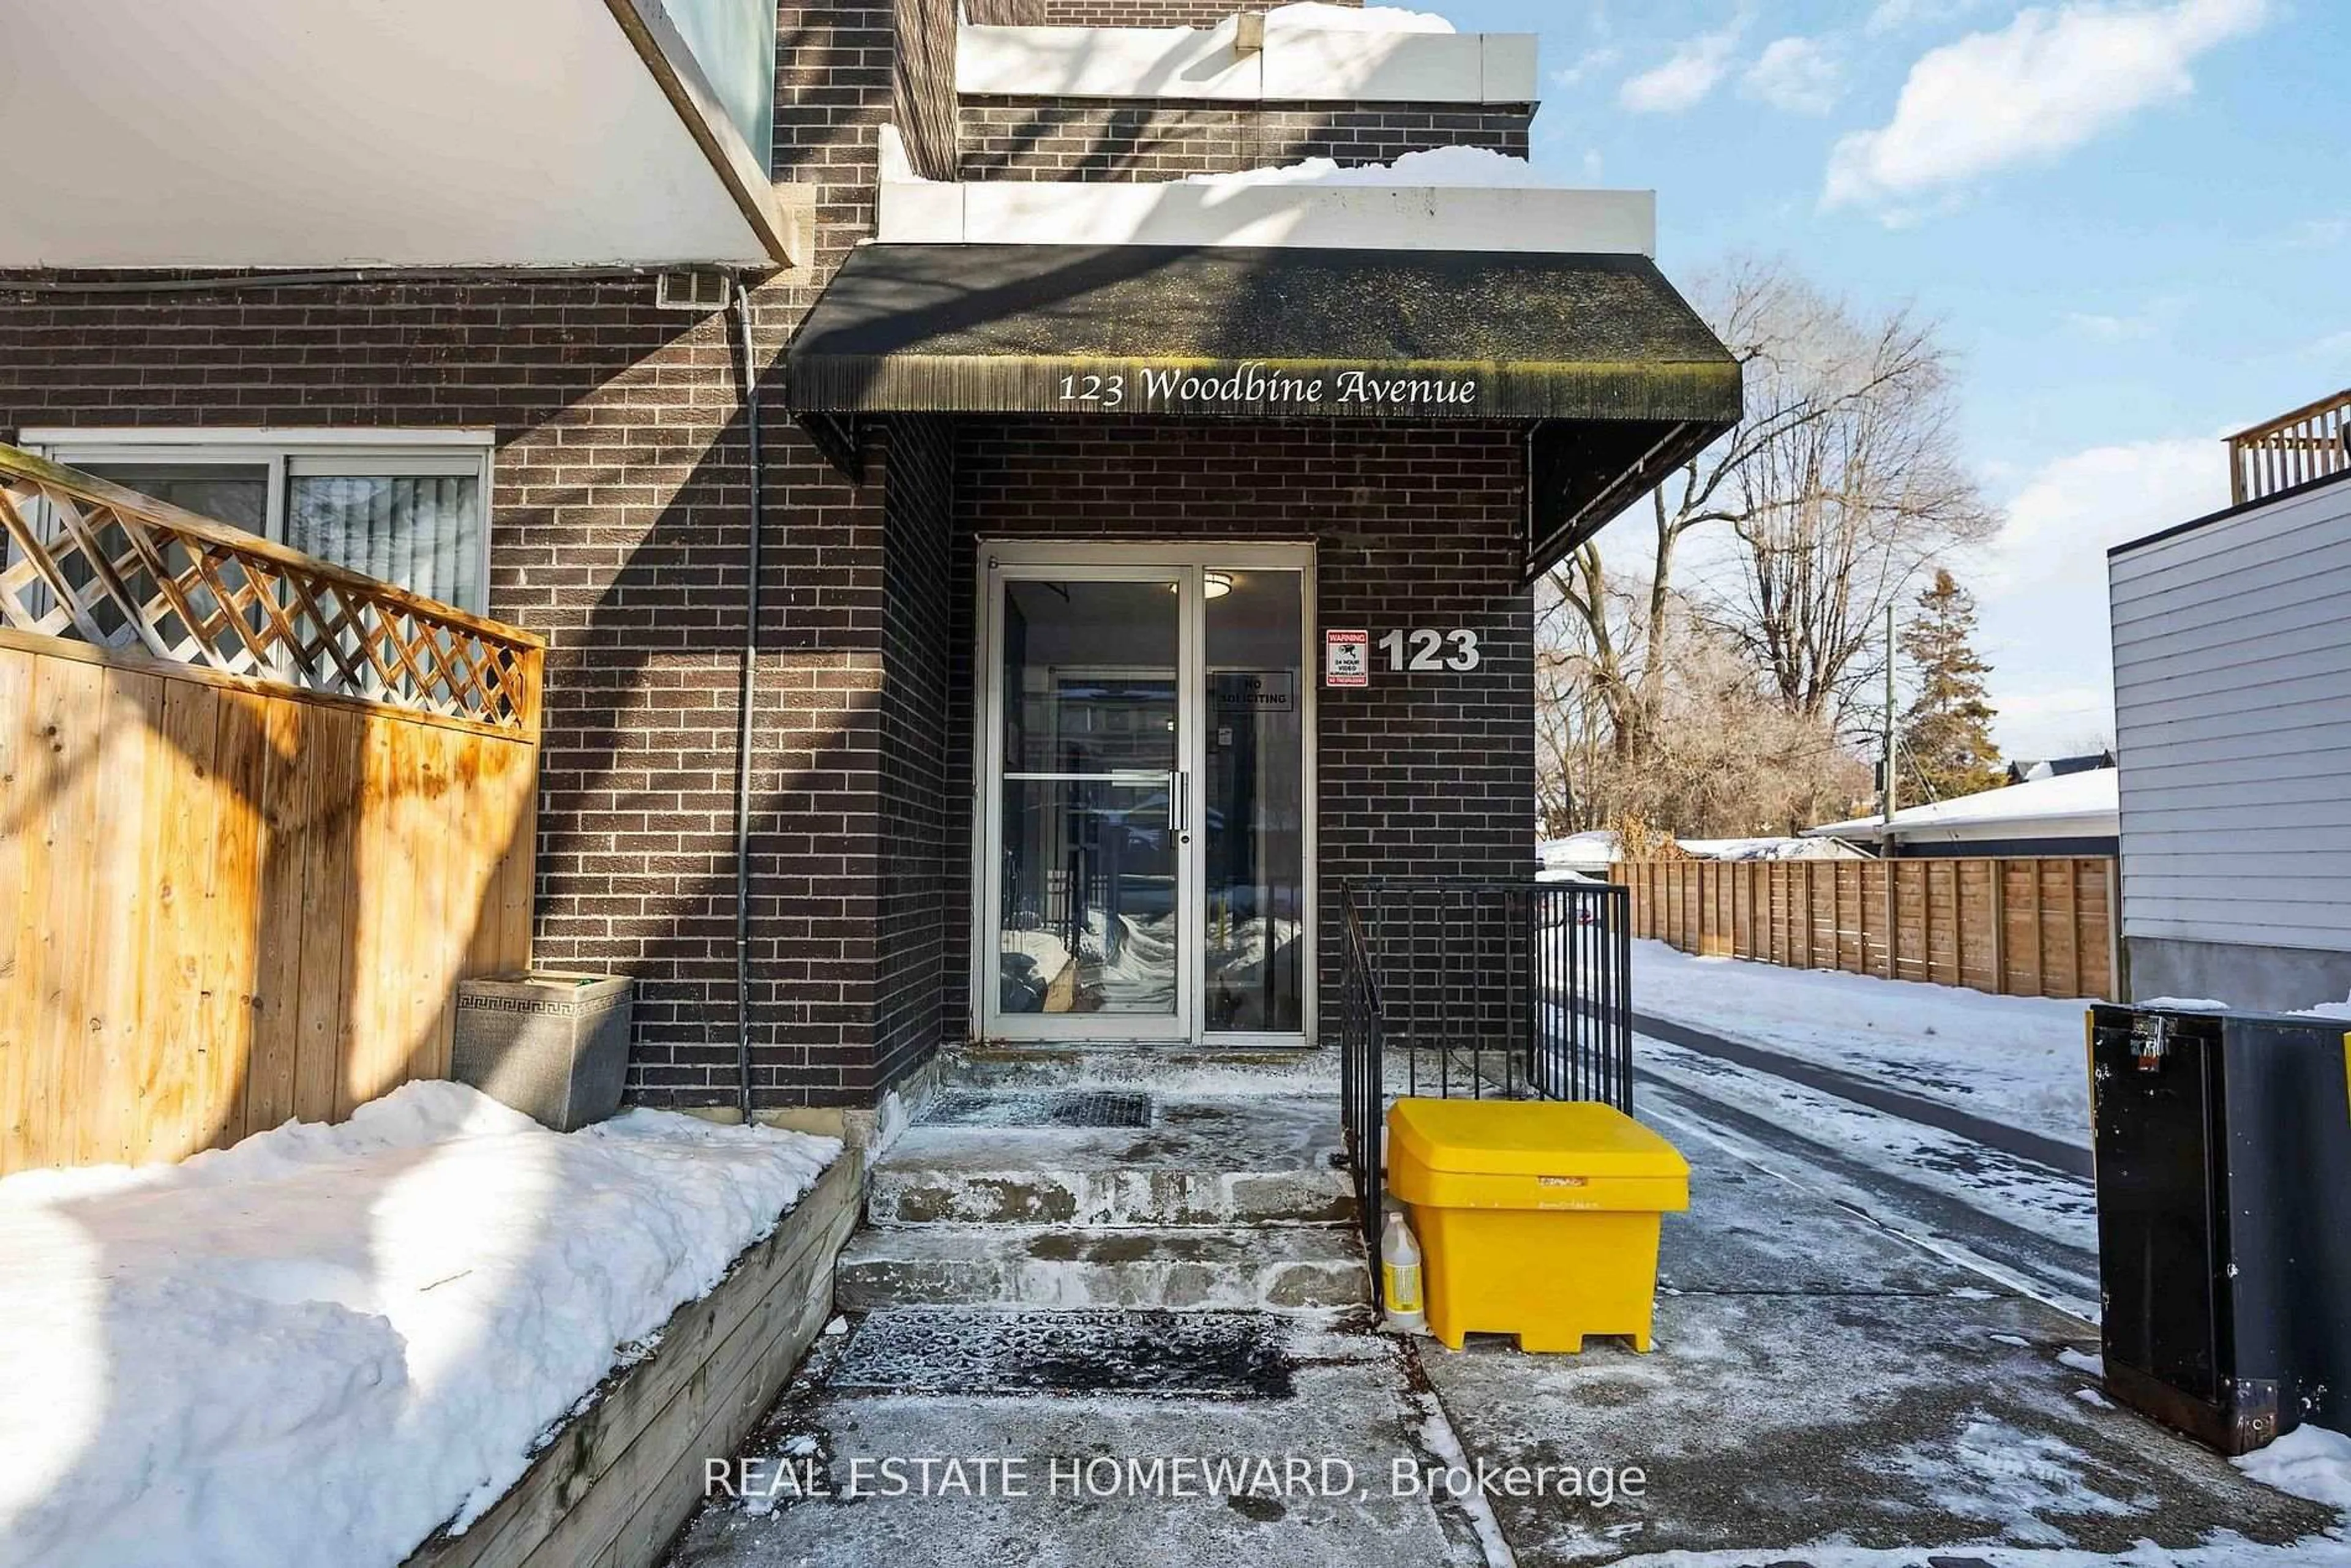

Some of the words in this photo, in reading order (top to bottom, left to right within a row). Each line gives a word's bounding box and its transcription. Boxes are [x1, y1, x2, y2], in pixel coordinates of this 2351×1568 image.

[1059, 375, 1124, 407] 123
[1140, 361, 1322, 403] Woodbine
[1337, 370, 1475, 404] Avenue
[1379, 629, 1480, 671] 123
